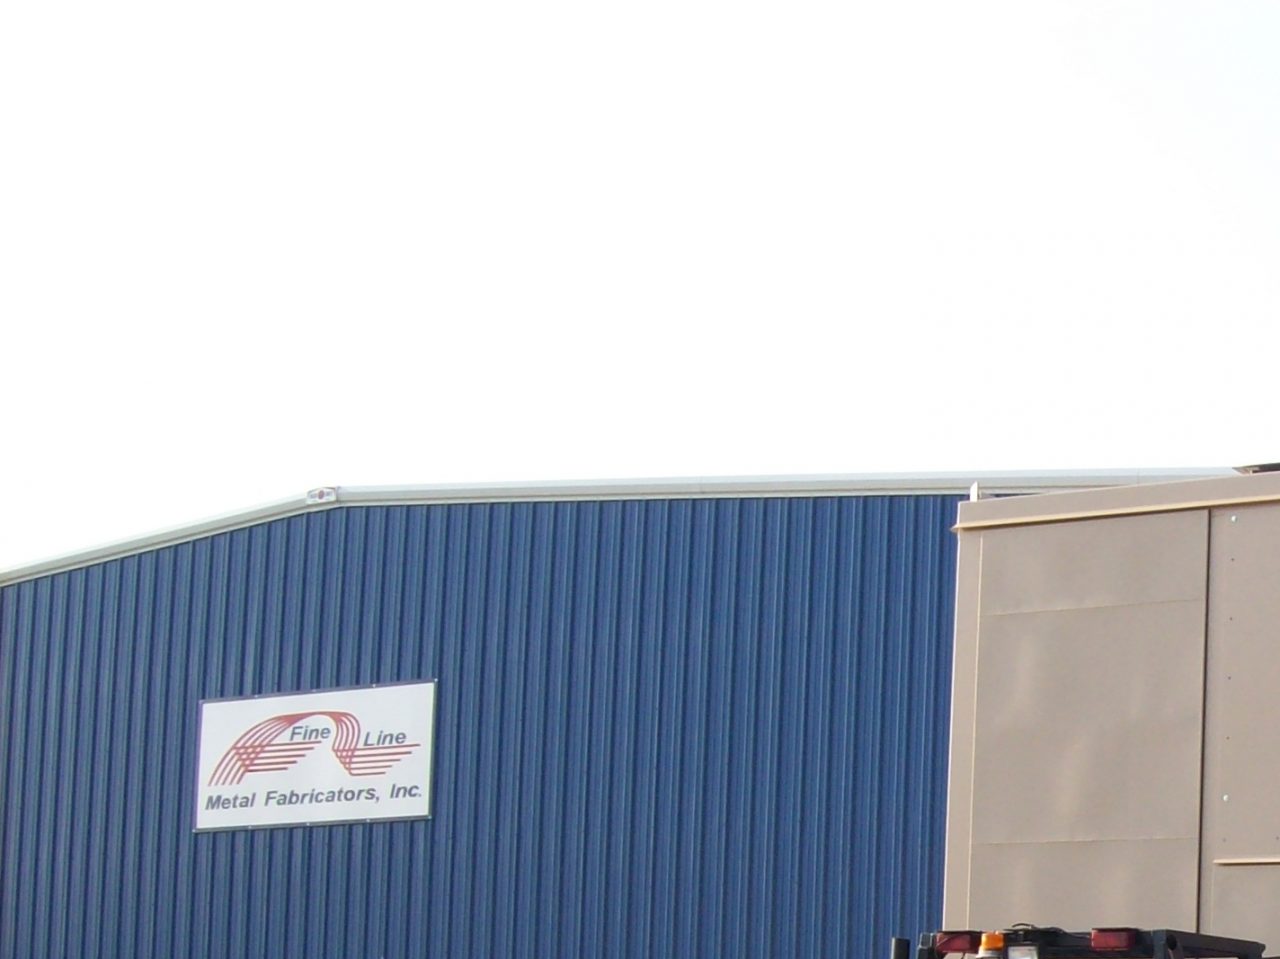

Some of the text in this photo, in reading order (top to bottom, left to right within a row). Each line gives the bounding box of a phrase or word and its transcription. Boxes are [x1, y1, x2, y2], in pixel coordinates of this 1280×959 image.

[289, 725, 407, 747] Fine Line
[205, 783, 422, 811] Metal Fabricators, Inc.
